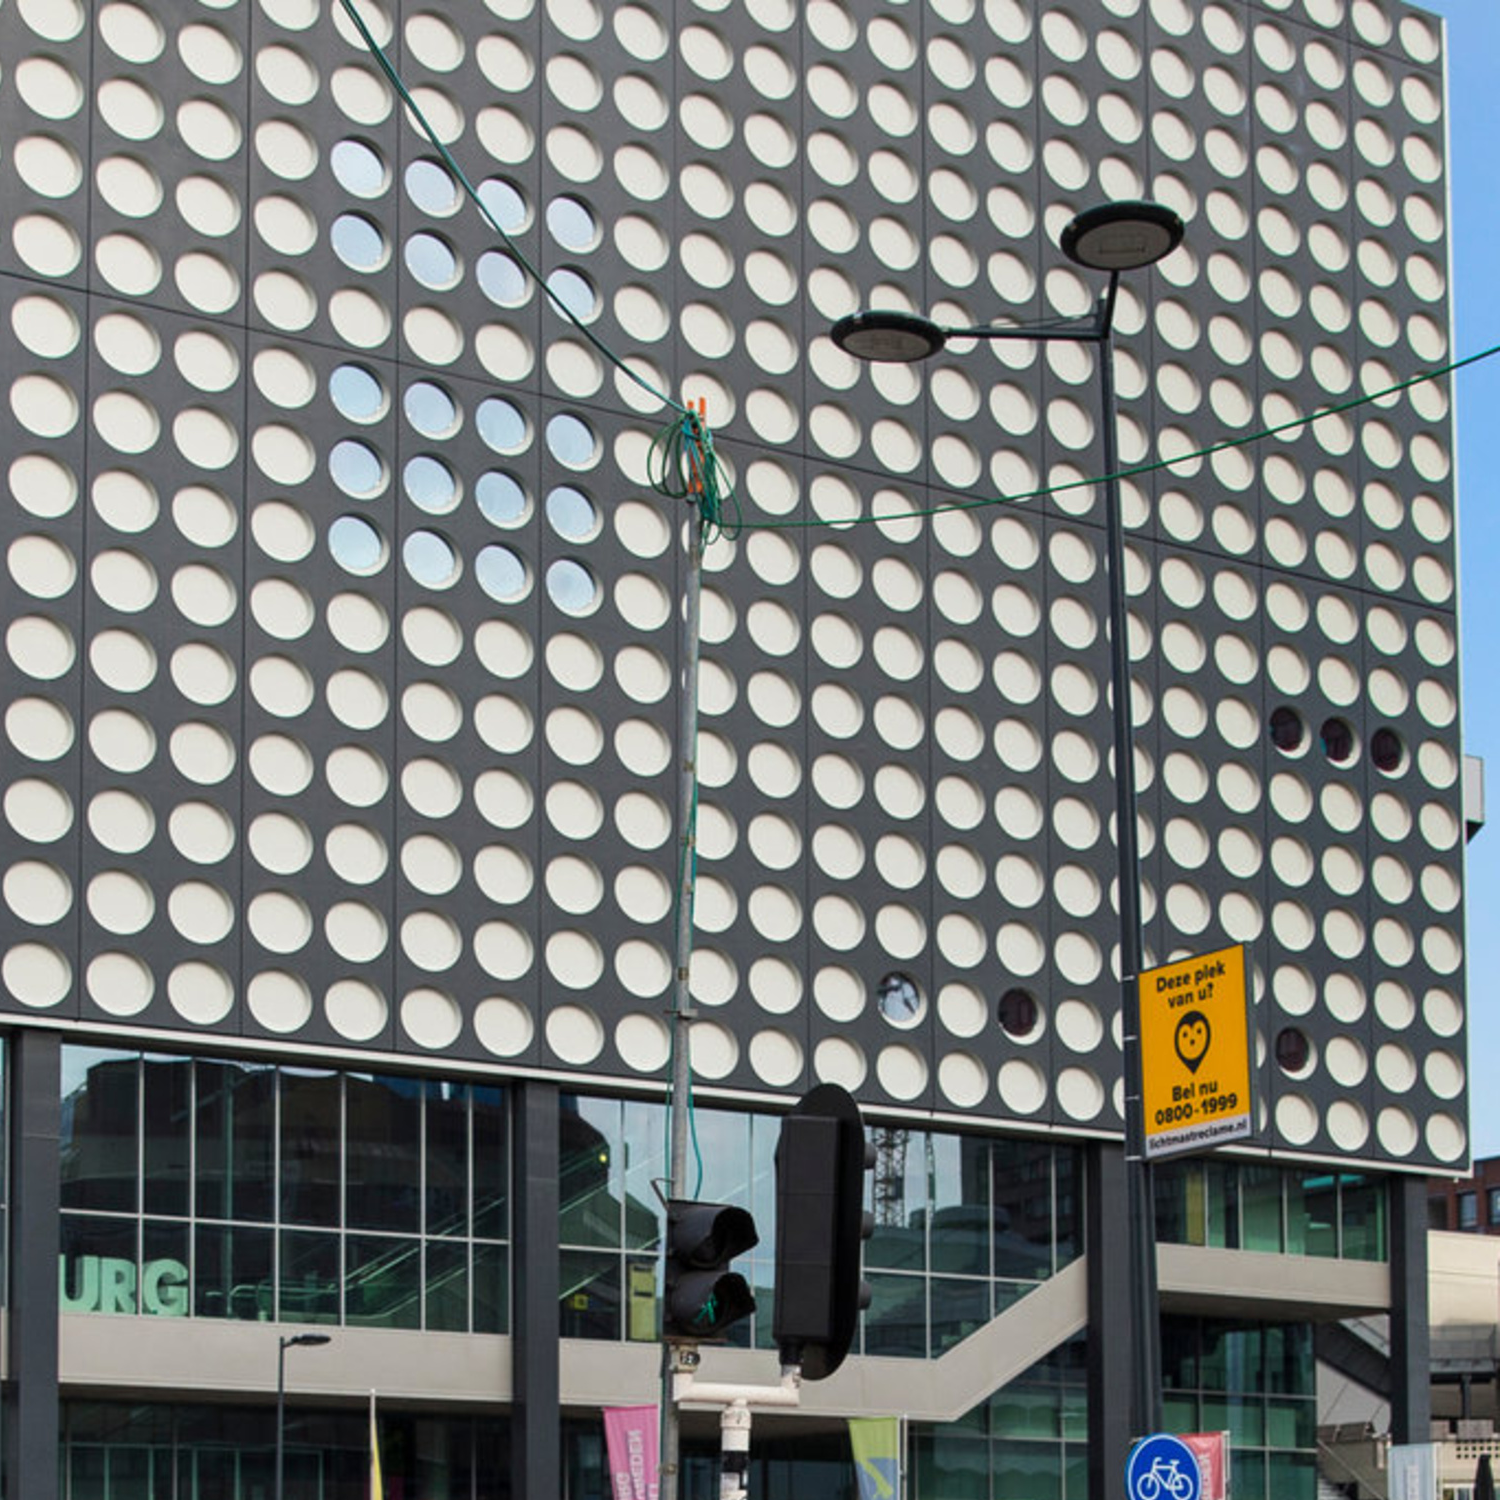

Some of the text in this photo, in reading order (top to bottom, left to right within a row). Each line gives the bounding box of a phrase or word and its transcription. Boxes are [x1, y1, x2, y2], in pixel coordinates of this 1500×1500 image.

[1156, 960, 1226, 993] Deze plek
[1168, 982, 1214, 1009] van u?
[1172, 1080, 1218, 1102] Bel nu
[1155, 1093, 1238, 1126] 0800-1999
[1150, 1119, 1247, 1150] lichtmastreclame.nl
